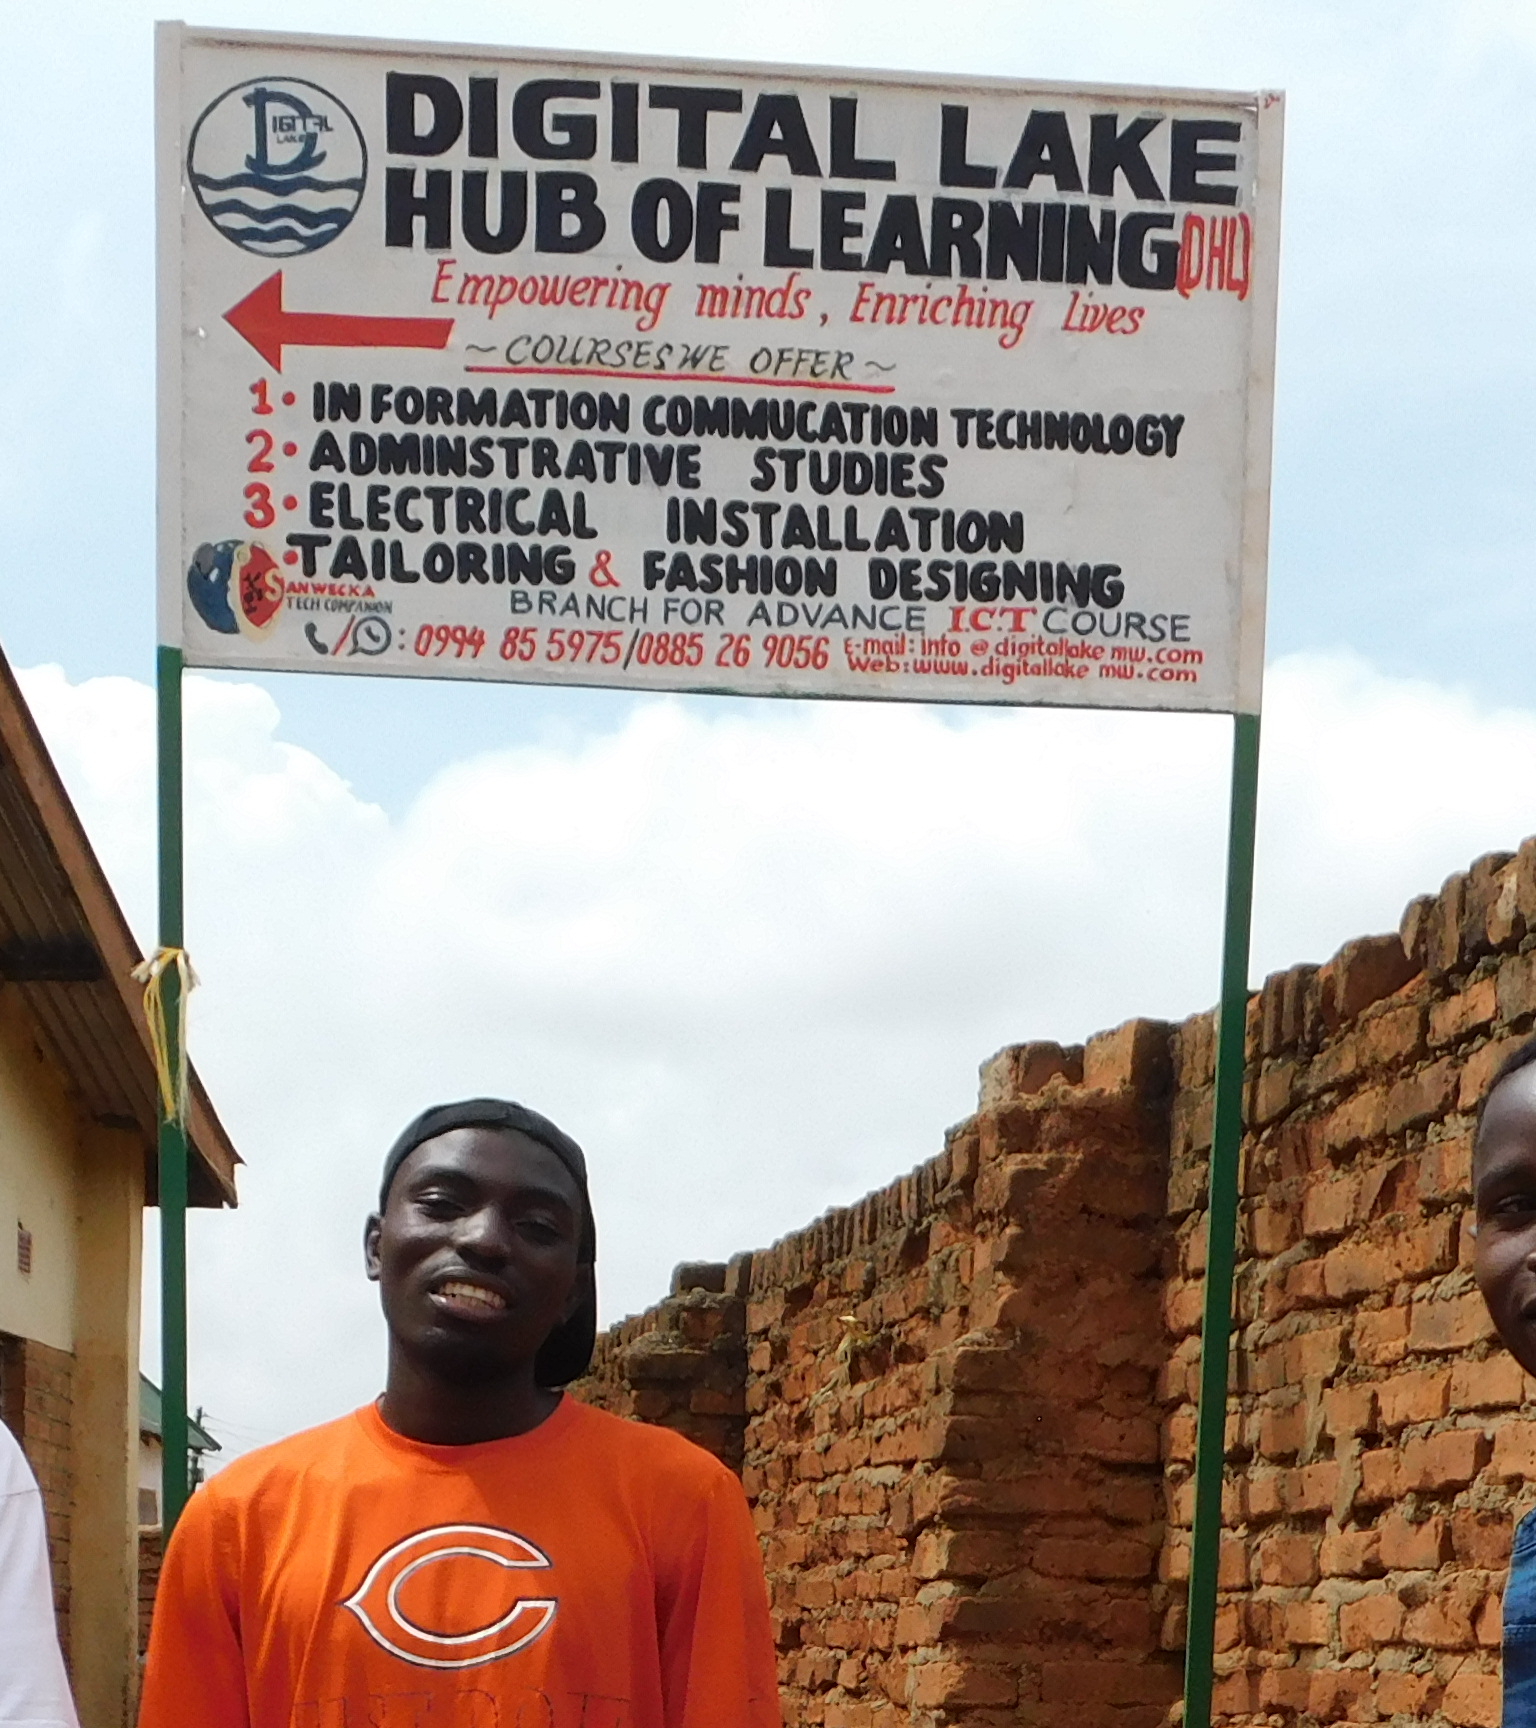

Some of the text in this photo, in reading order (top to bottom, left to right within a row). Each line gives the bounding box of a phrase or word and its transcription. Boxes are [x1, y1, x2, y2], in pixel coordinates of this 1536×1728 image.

[386, 71, 1243, 206] DIGITAL LAKE
[385, 167, 606, 254] HUB
[631, 178, 741, 263] OF
[764, 186, 1180, 290] LEARNING
[430, 257, 671, 331] Empowering
[850, 282, 1034, 349] Enriching
[1063, 290, 1146, 335] Lives
[749, 347, 855, 380] OFFER
[642, 395, 939, 448] COMMUCATION
[950, 408, 1185, 458] TECHNOLOGY
[309, 430, 702, 488] ADMINSTRATIVE
[750, 446, 948, 499] STUDIES
[309, 481, 598, 540] ELECTRICAL
[667, 497, 1024, 553] INSTALLATION
[286, 533, 1125, 609] TAILORING & FASHION DESIGNING
[286, 596, 321, 612] TECH
[414, 624, 485, 658] 0994
[499, 626, 536, 662] 85
[714, 633, 751, 667] 26
[764, 633, 830, 670] 9056
[510, 590, 648, 625] BRANCH
[664, 599, 725, 627] FOR
[747, 600, 927, 632] ADVANCE
[1041, 607, 1191, 643] COURSE
